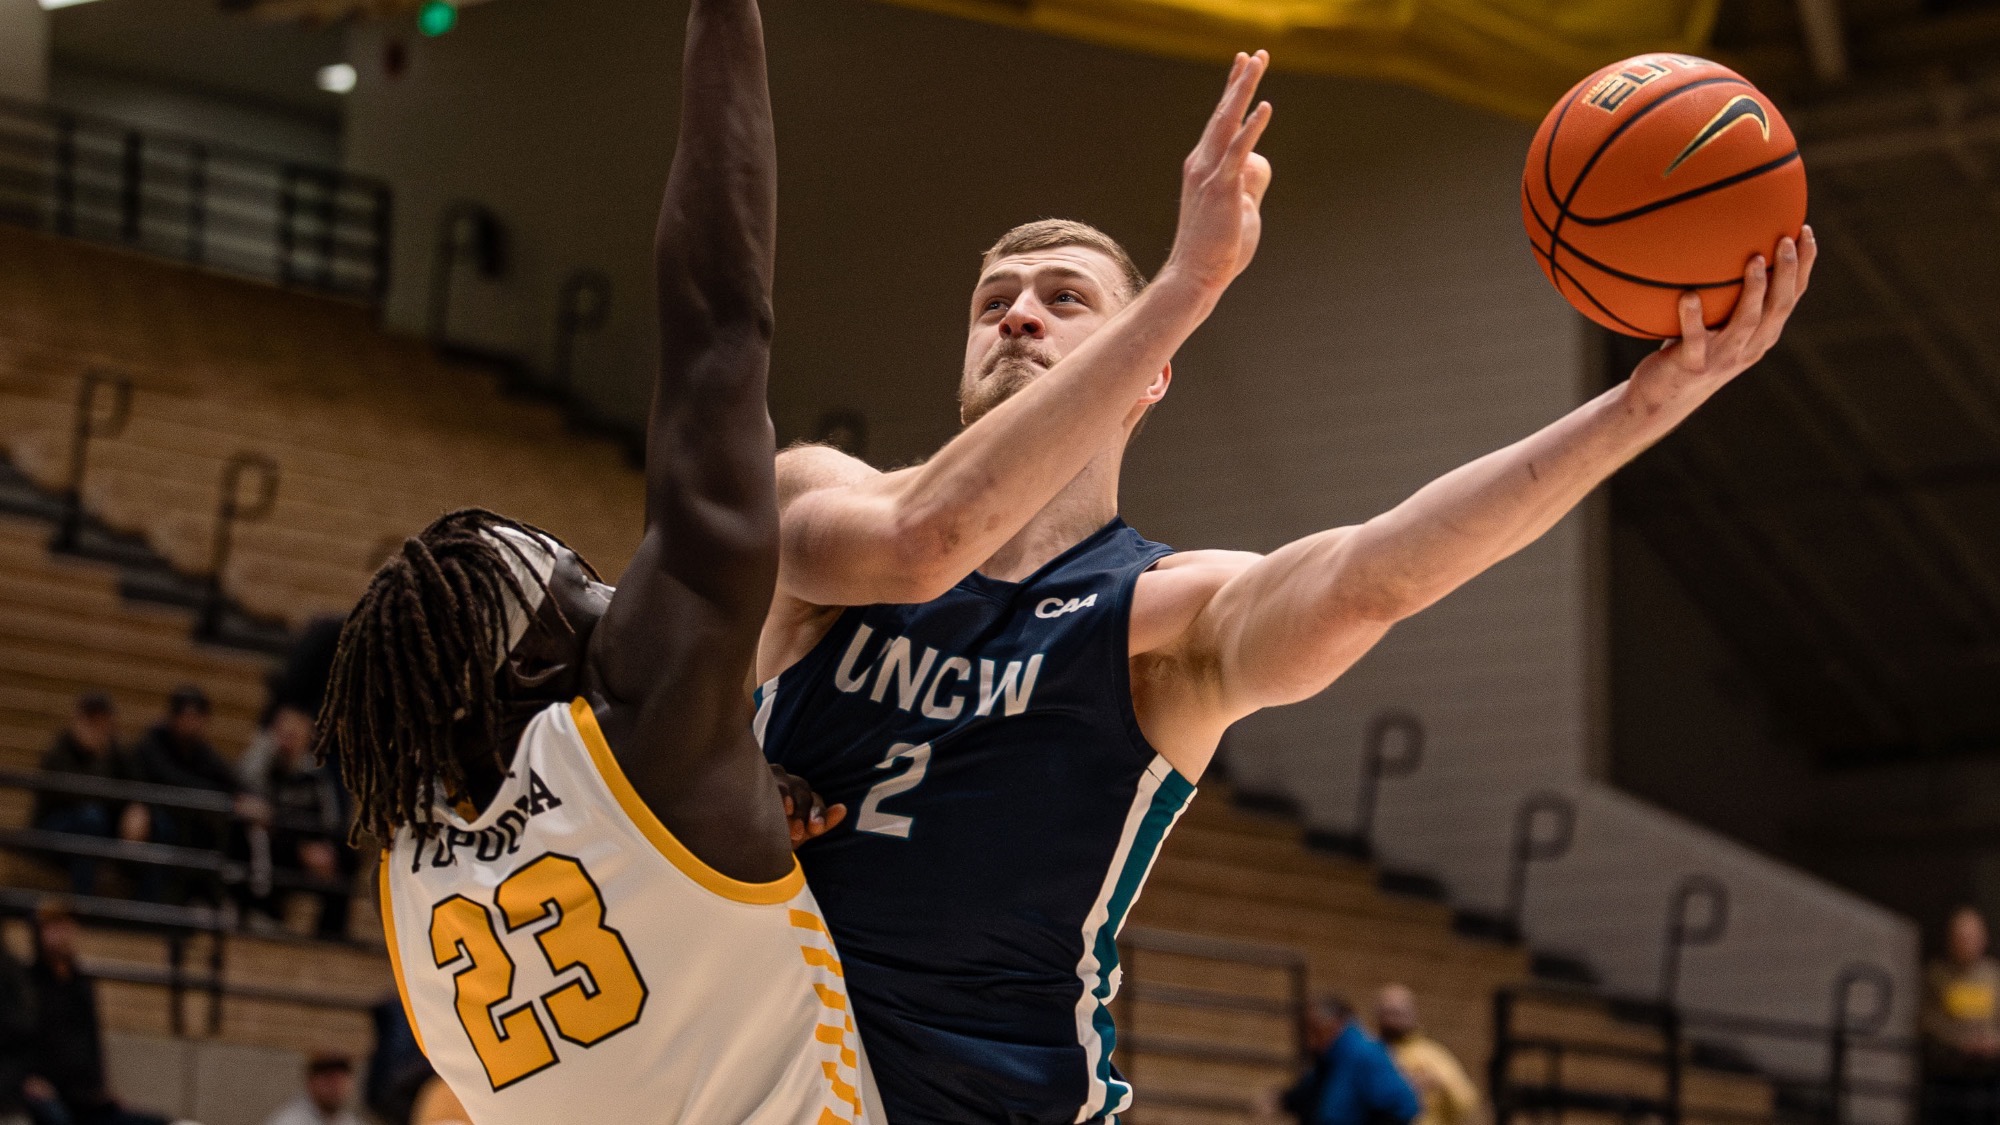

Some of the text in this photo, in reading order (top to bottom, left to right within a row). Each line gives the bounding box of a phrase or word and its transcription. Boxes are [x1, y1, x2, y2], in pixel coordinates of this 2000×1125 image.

[1035, 593, 1098, 619] CAA
[834, 623, 1044, 721] UNCW
[855, 741, 933, 839] 2
[428, 850, 650, 1094] 23
